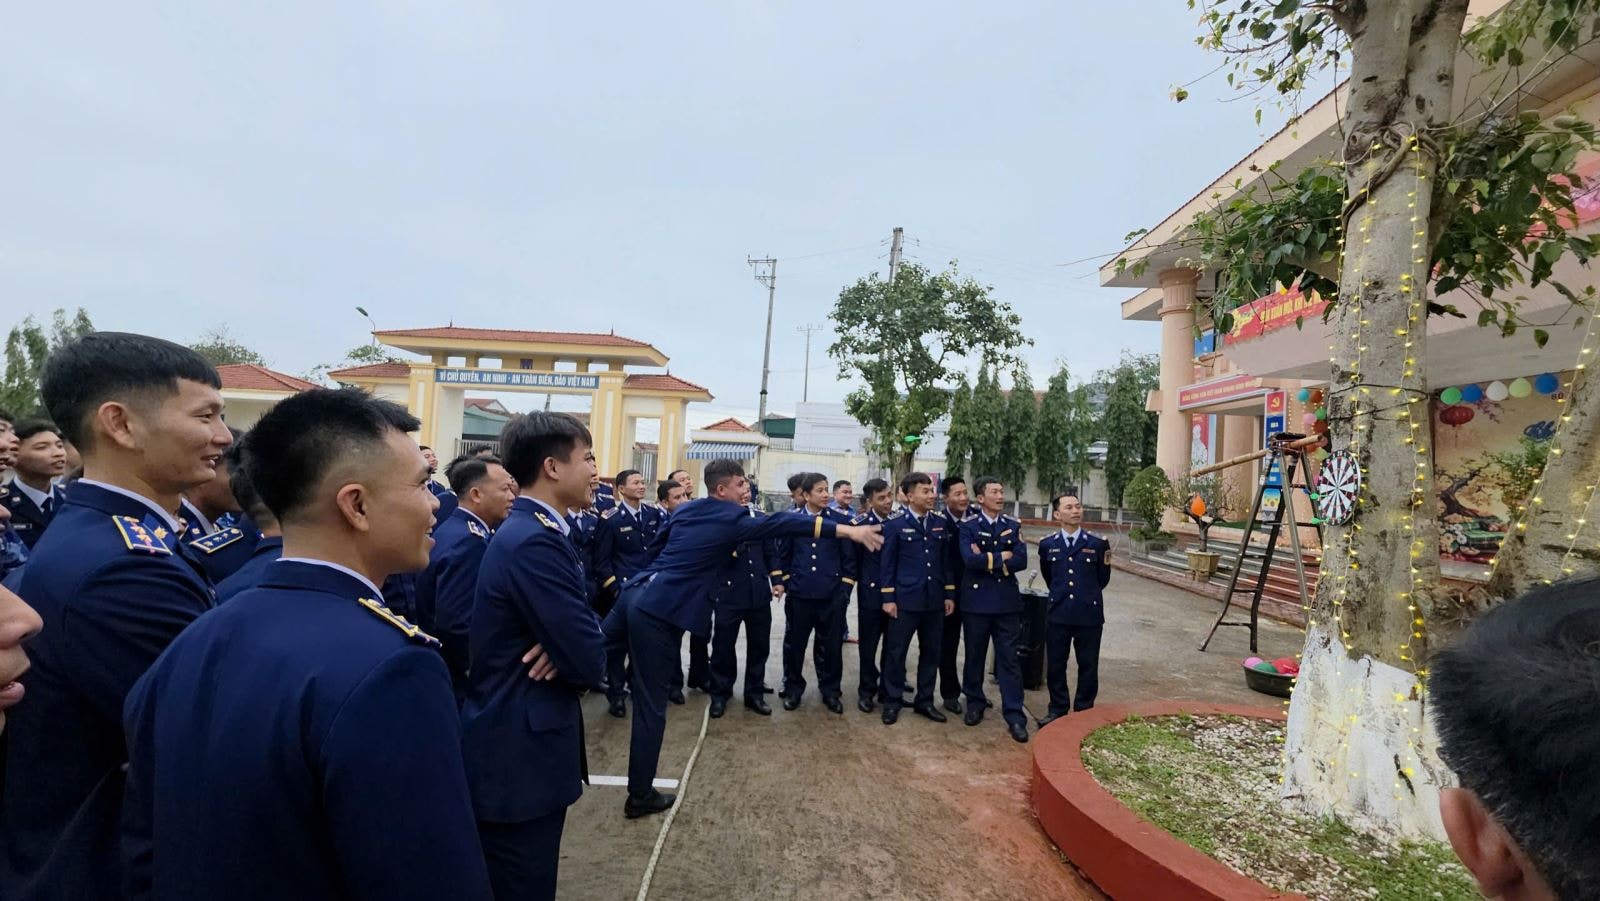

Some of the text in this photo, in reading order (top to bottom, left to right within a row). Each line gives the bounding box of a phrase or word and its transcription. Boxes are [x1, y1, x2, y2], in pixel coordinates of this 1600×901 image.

[483, 373, 491, 382] AN
[492, 373, 507, 383] NINH
[511, 374, 520, 384] AN
[581, 376, 595, 387] NAM
